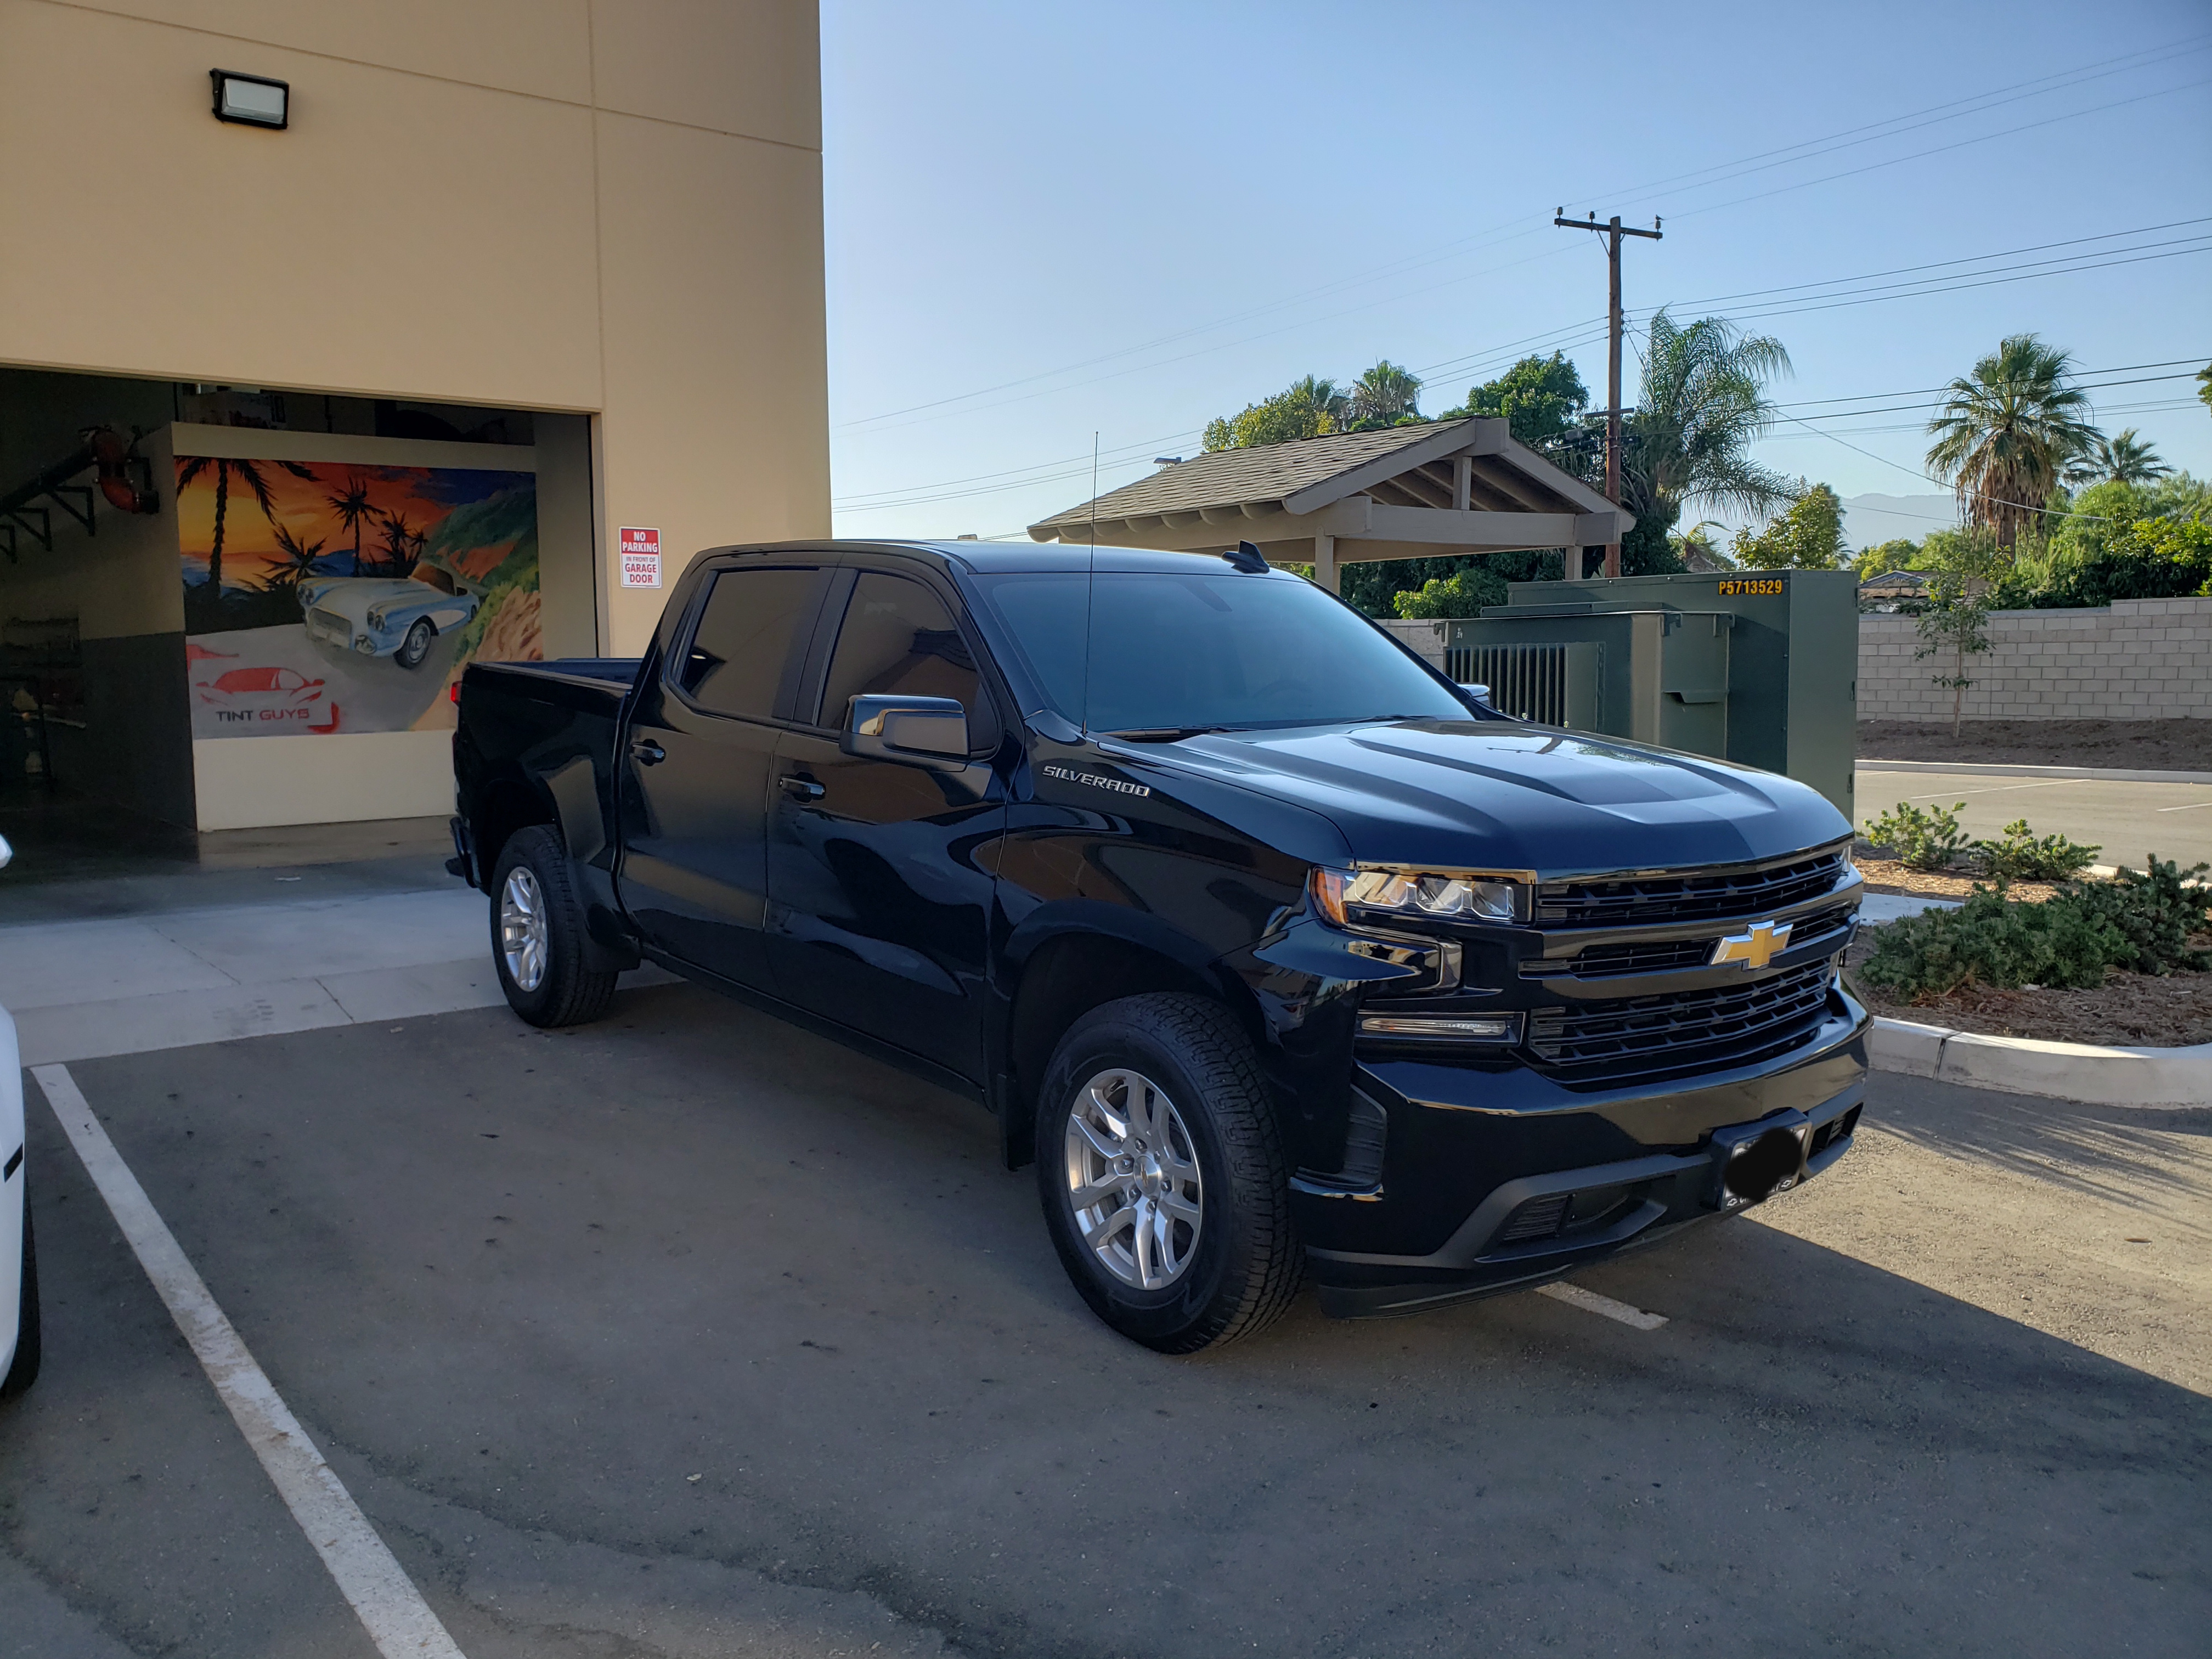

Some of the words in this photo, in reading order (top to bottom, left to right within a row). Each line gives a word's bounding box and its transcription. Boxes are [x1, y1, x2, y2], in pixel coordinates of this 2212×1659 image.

[634, 531, 646, 541] NO
[622, 542, 658, 553] PARKING
[625, 563, 657, 573] GARAGE
[630, 574, 653, 583] DOOR
[1718, 579, 1782, 595] P5713529
[216, 710, 253, 722] TINT
[259, 708, 310, 721] GUYS
[1042, 765, 1151, 799] SILVERADO
